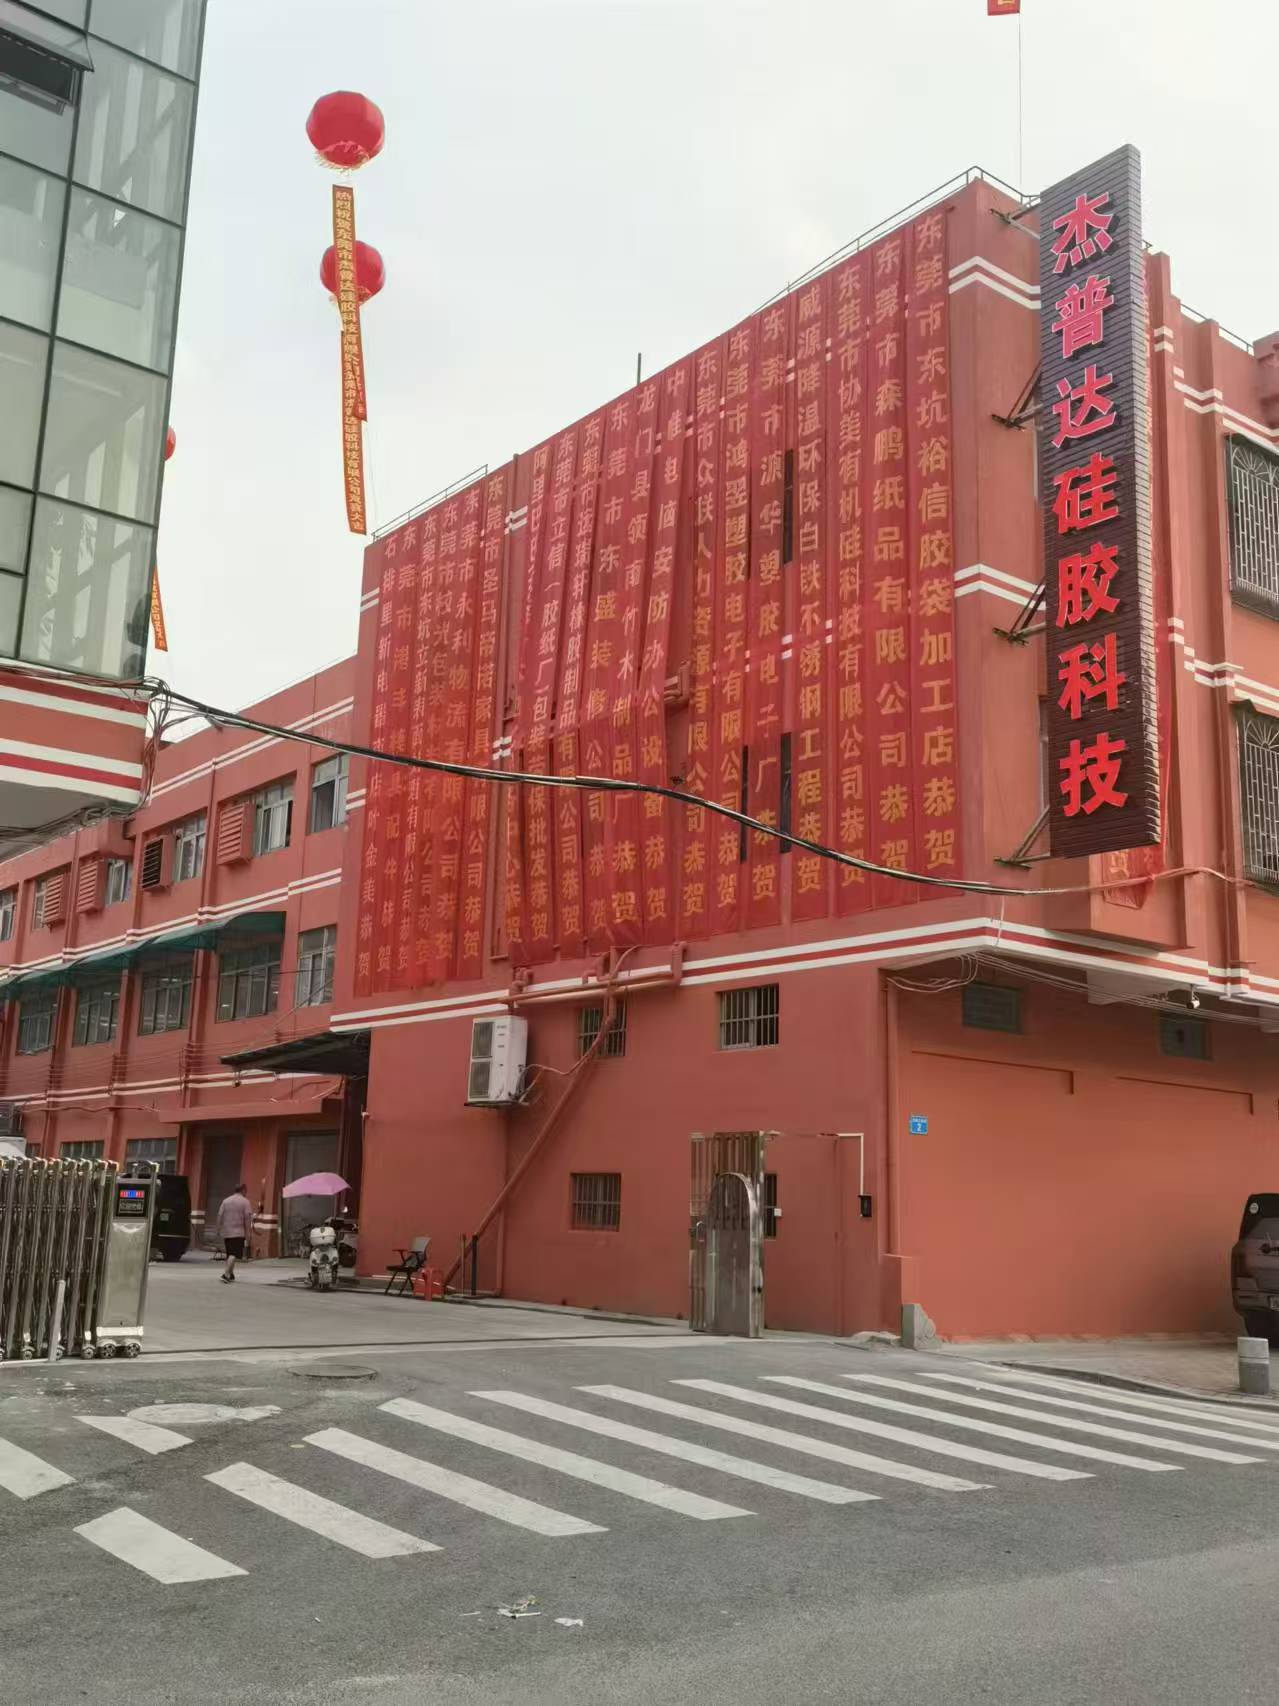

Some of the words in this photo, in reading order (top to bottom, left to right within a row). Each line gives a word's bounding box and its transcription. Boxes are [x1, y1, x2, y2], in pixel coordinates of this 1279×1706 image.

[873, 239, 908, 878] 东莞市森鹏纸品有限公司恭贺
[917, 213, 956, 869] 东莞市东坑裕信胶袋加工店恭贺
[1050, 191, 1129, 817] 杰普达硅胶科技
